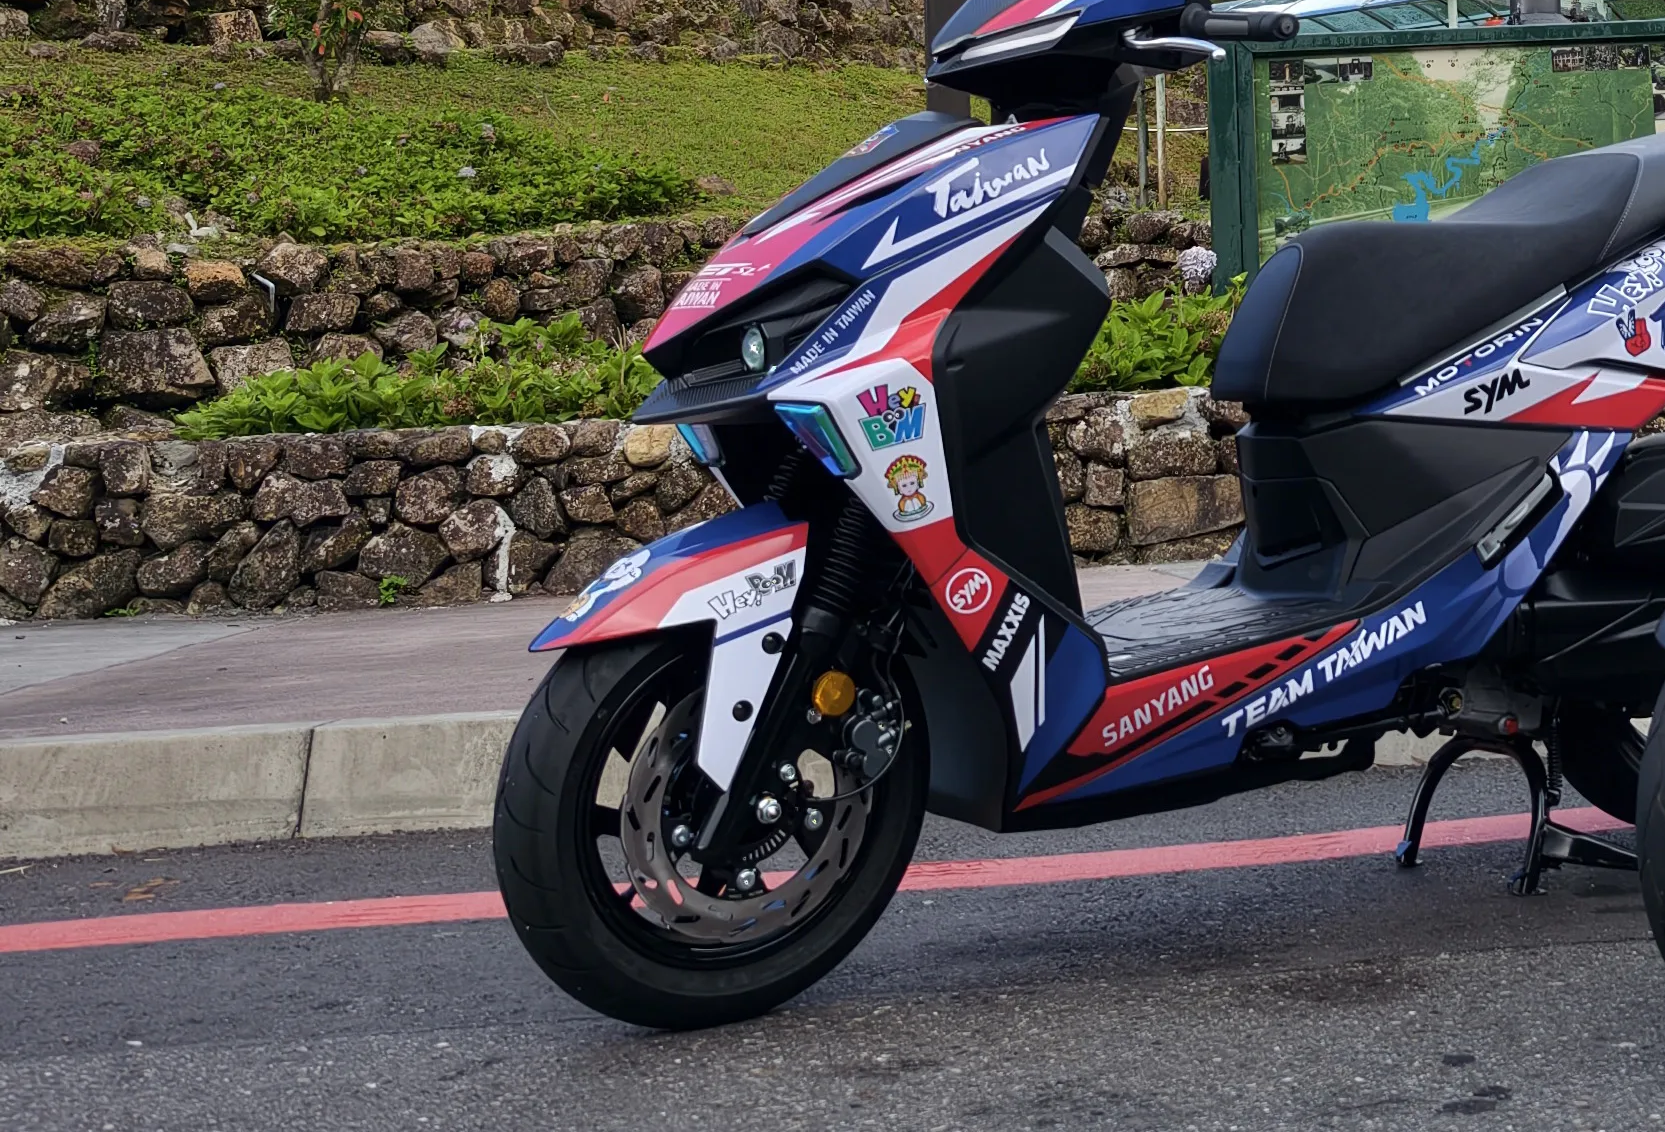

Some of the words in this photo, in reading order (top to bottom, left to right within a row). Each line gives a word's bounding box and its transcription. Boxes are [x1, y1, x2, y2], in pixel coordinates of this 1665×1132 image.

[790, 341, 825, 374] MADE
[821, 327, 839, 345] IN
[834, 289, 876, 330] TAIWAN
[1464, 369, 1531, 415] SYM
[951, 571, 989, 611] SYM
[981, 591, 1031, 672] MAXXIS
[1102, 665, 1214, 748] SANYANG
[1221, 669, 1314, 738] TEAM
[1317, 600, 1428, 683] TAIWAN
